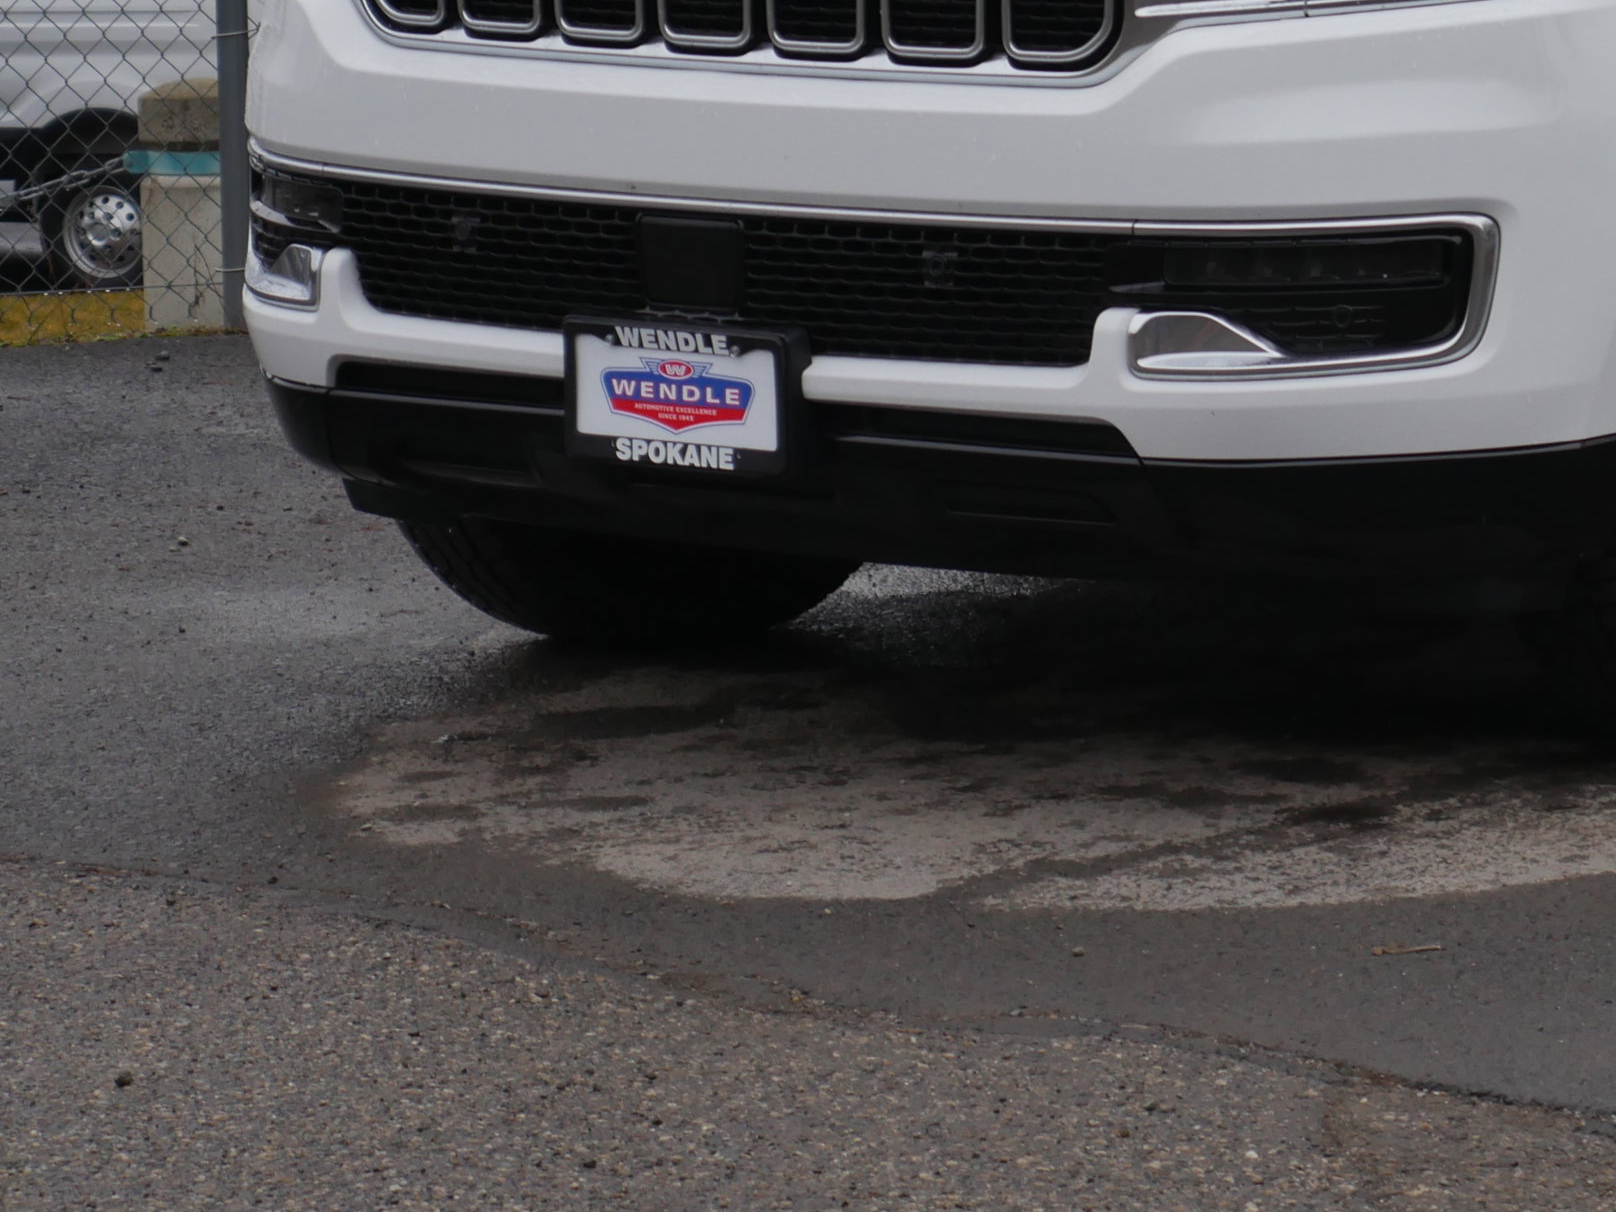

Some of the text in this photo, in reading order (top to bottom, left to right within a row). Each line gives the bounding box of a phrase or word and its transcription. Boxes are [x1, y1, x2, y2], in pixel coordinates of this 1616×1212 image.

[615, 326, 730, 355] WENDLE
[665, 363, 687, 377] W
[611, 378, 740, 405] WENDLE
[634, 403, 718, 416] AUTOMOTIVE EXCELLENCE
[658, 412, 677, 421] SINCE
[615, 438, 735, 470] SPOKANE
